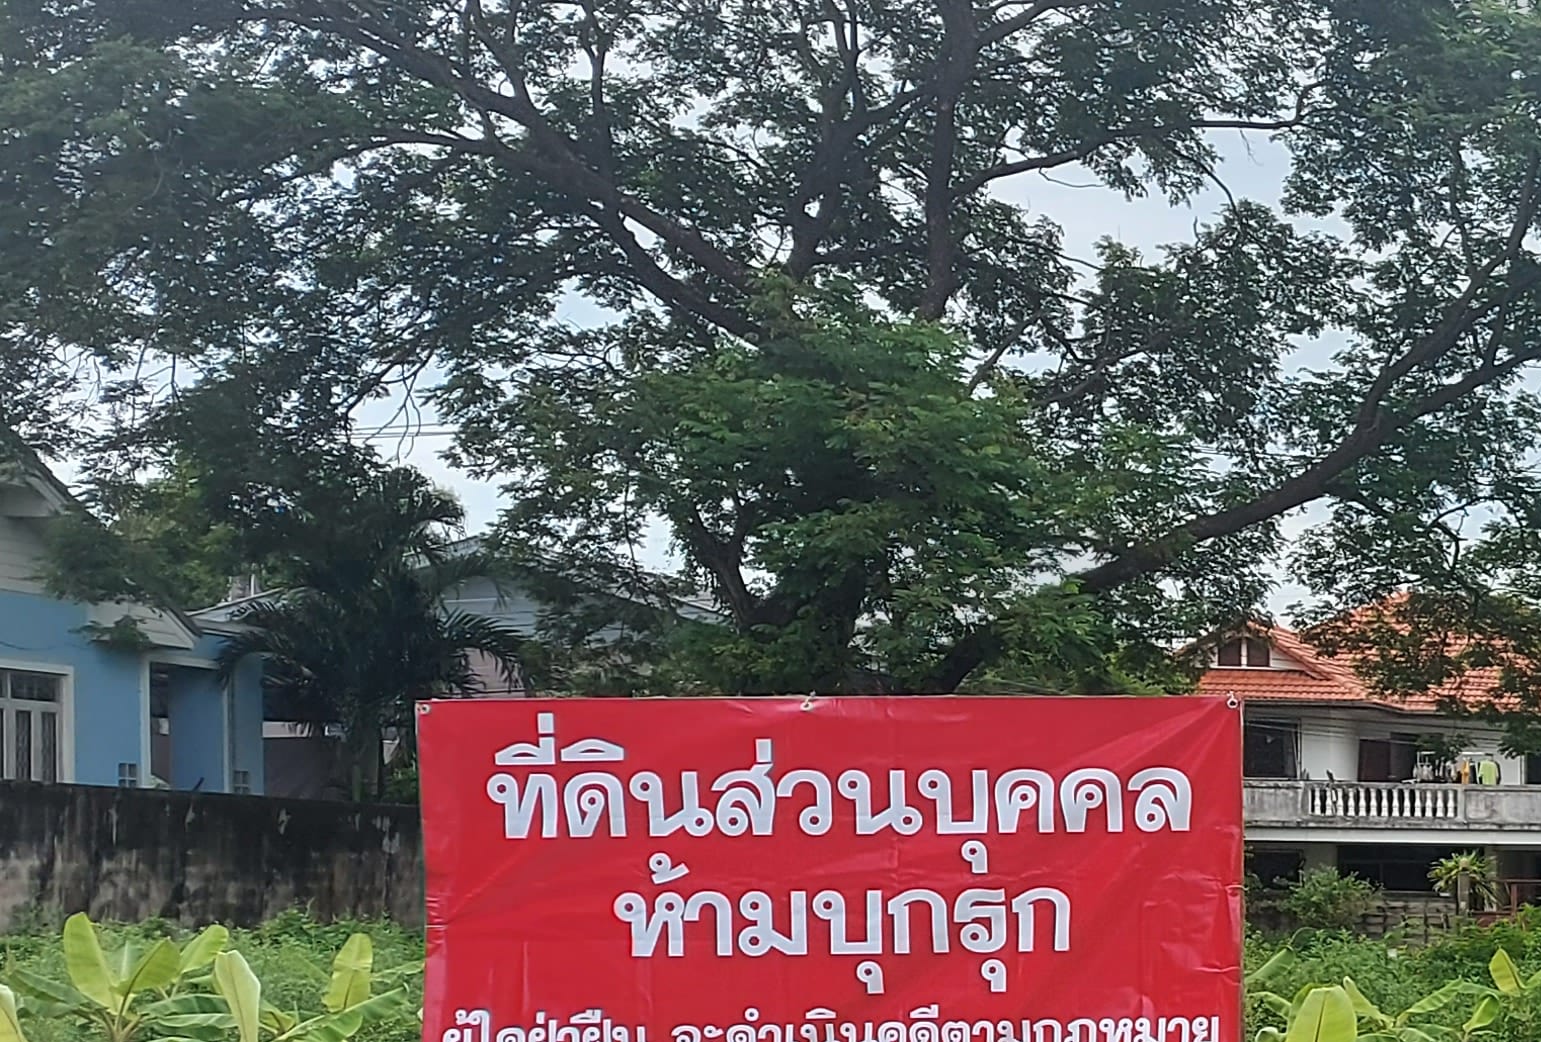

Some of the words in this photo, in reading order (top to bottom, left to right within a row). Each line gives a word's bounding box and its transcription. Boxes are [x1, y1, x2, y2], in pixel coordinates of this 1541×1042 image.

[487, 712, 1192, 874] ที่ดินส่วนบุคคล
[614, 852, 1071, 994] ห้ามบุกรุก
